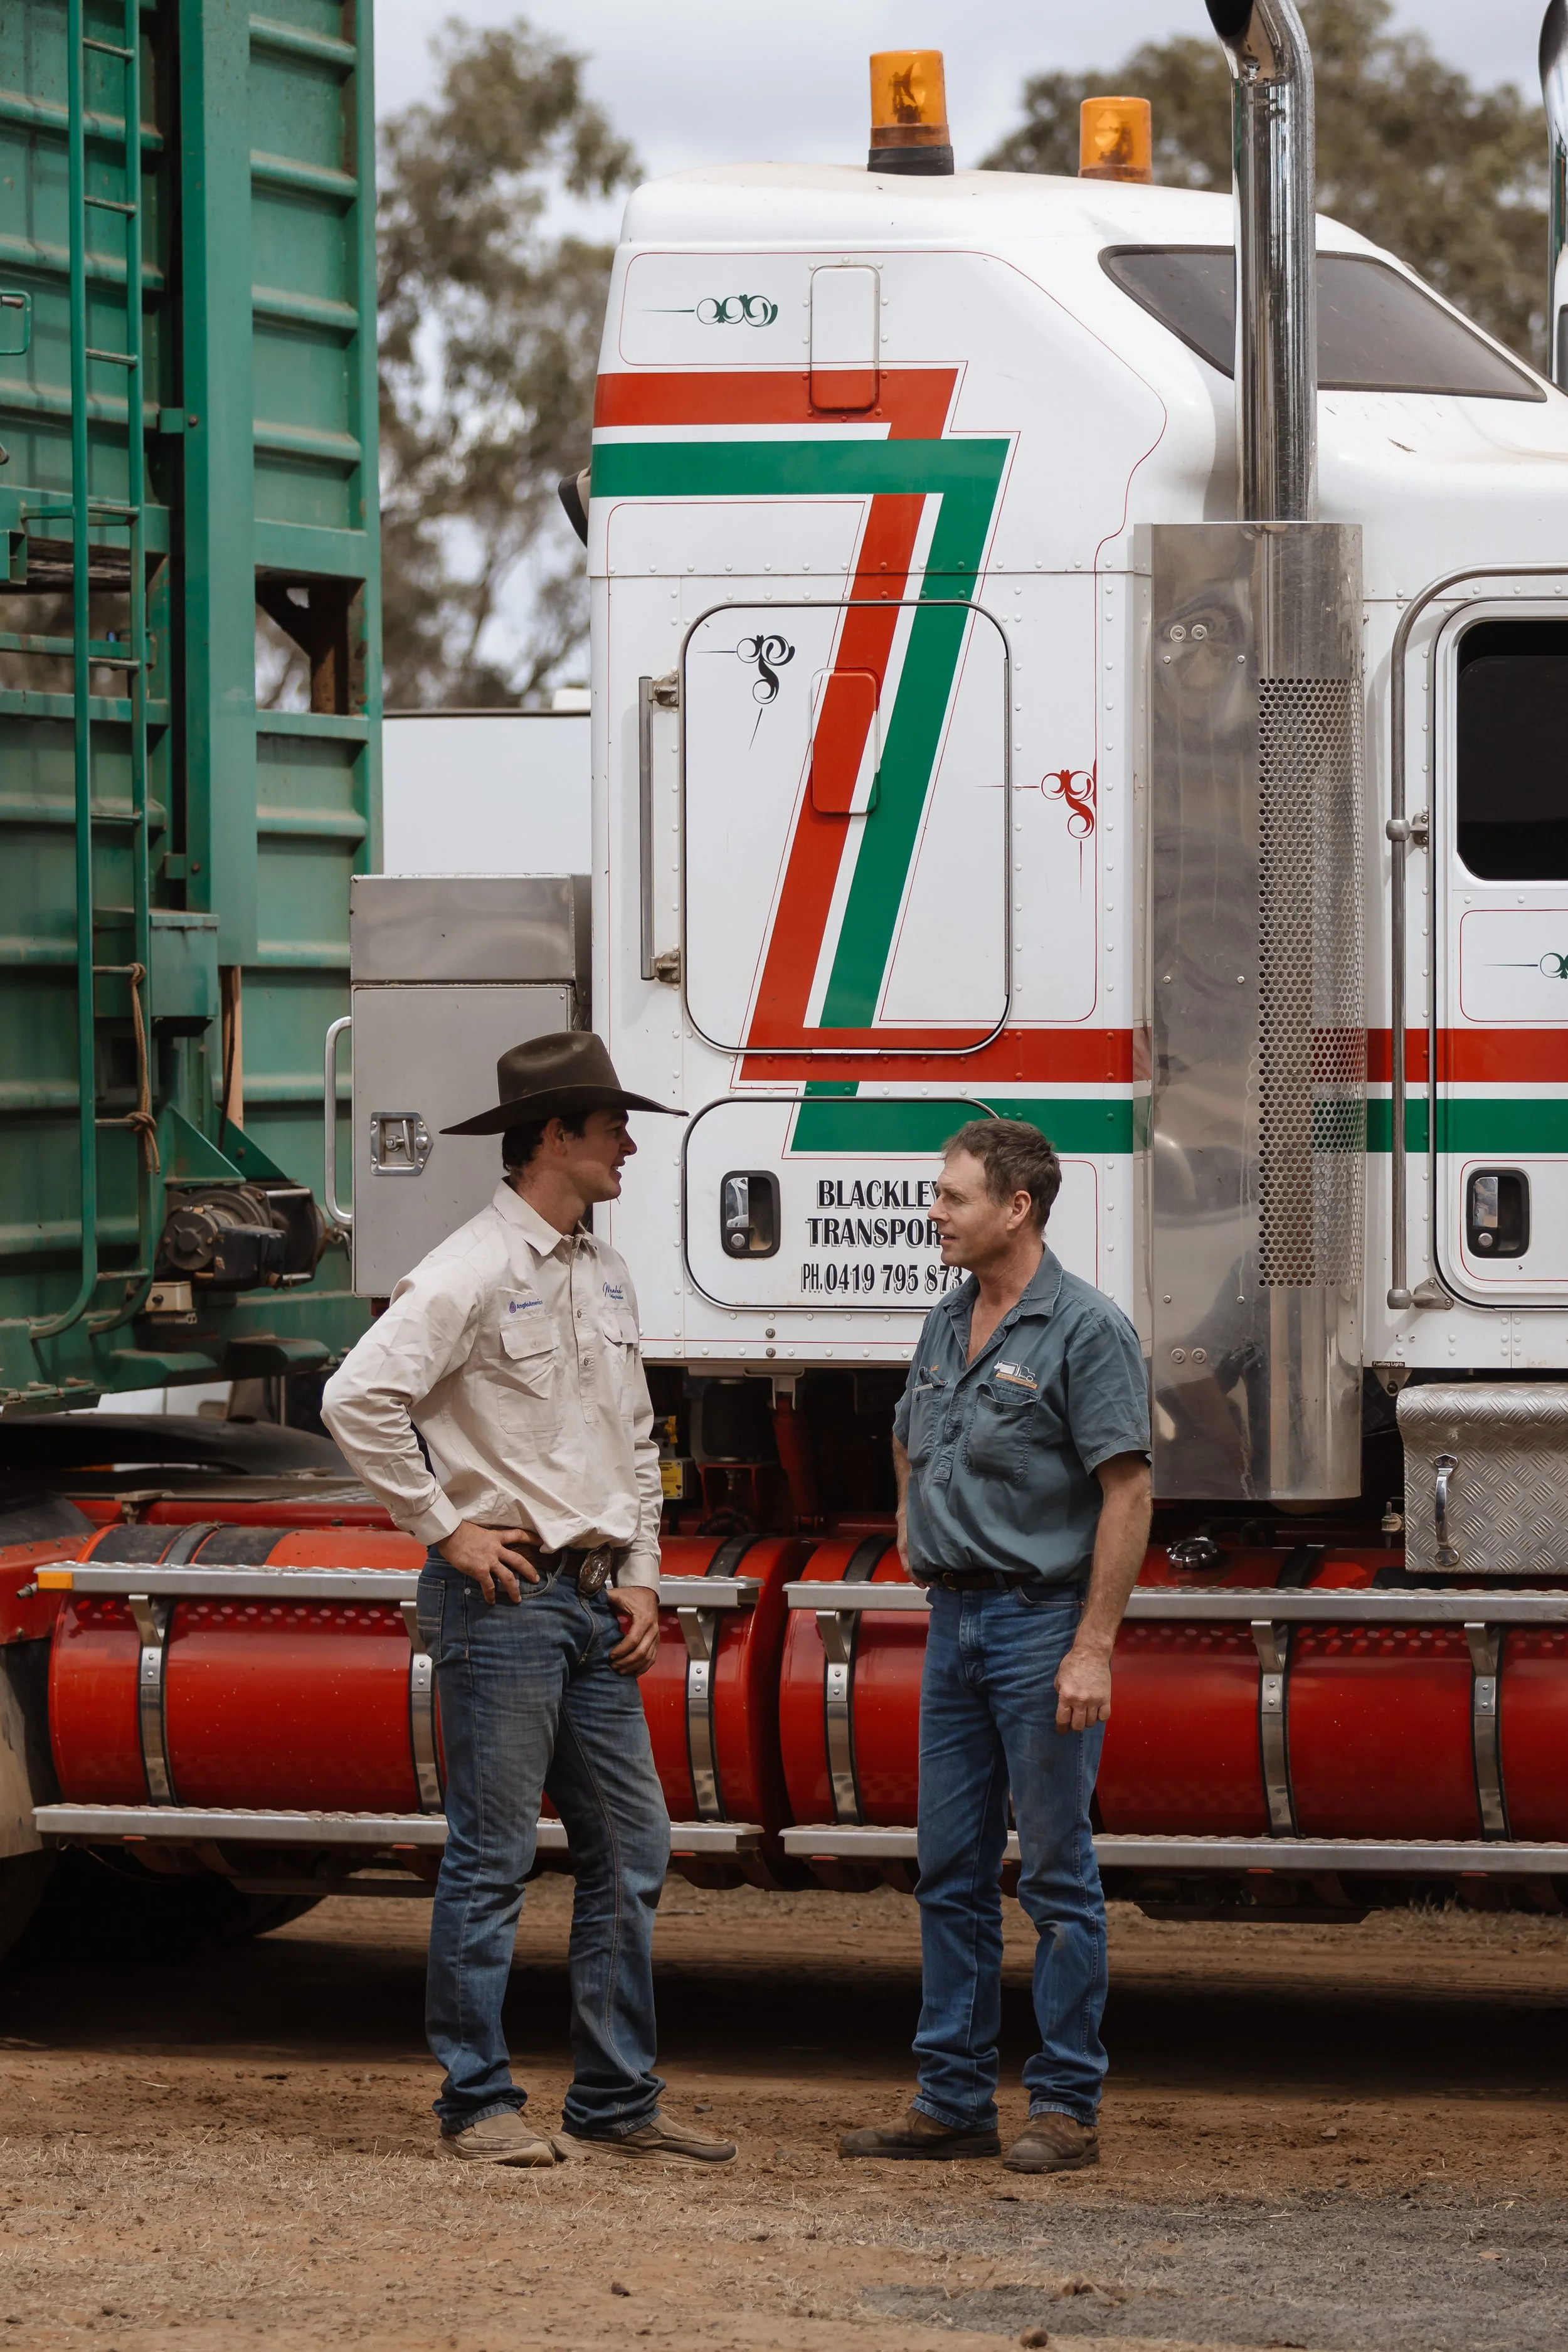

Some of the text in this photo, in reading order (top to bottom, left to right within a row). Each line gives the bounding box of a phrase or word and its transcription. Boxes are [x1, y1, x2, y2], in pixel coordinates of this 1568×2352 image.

[805, 1217, 941, 1248] TRANSPOR
[881, 1264, 919, 1295] 795
[925, 1264, 963, 1295] 873
